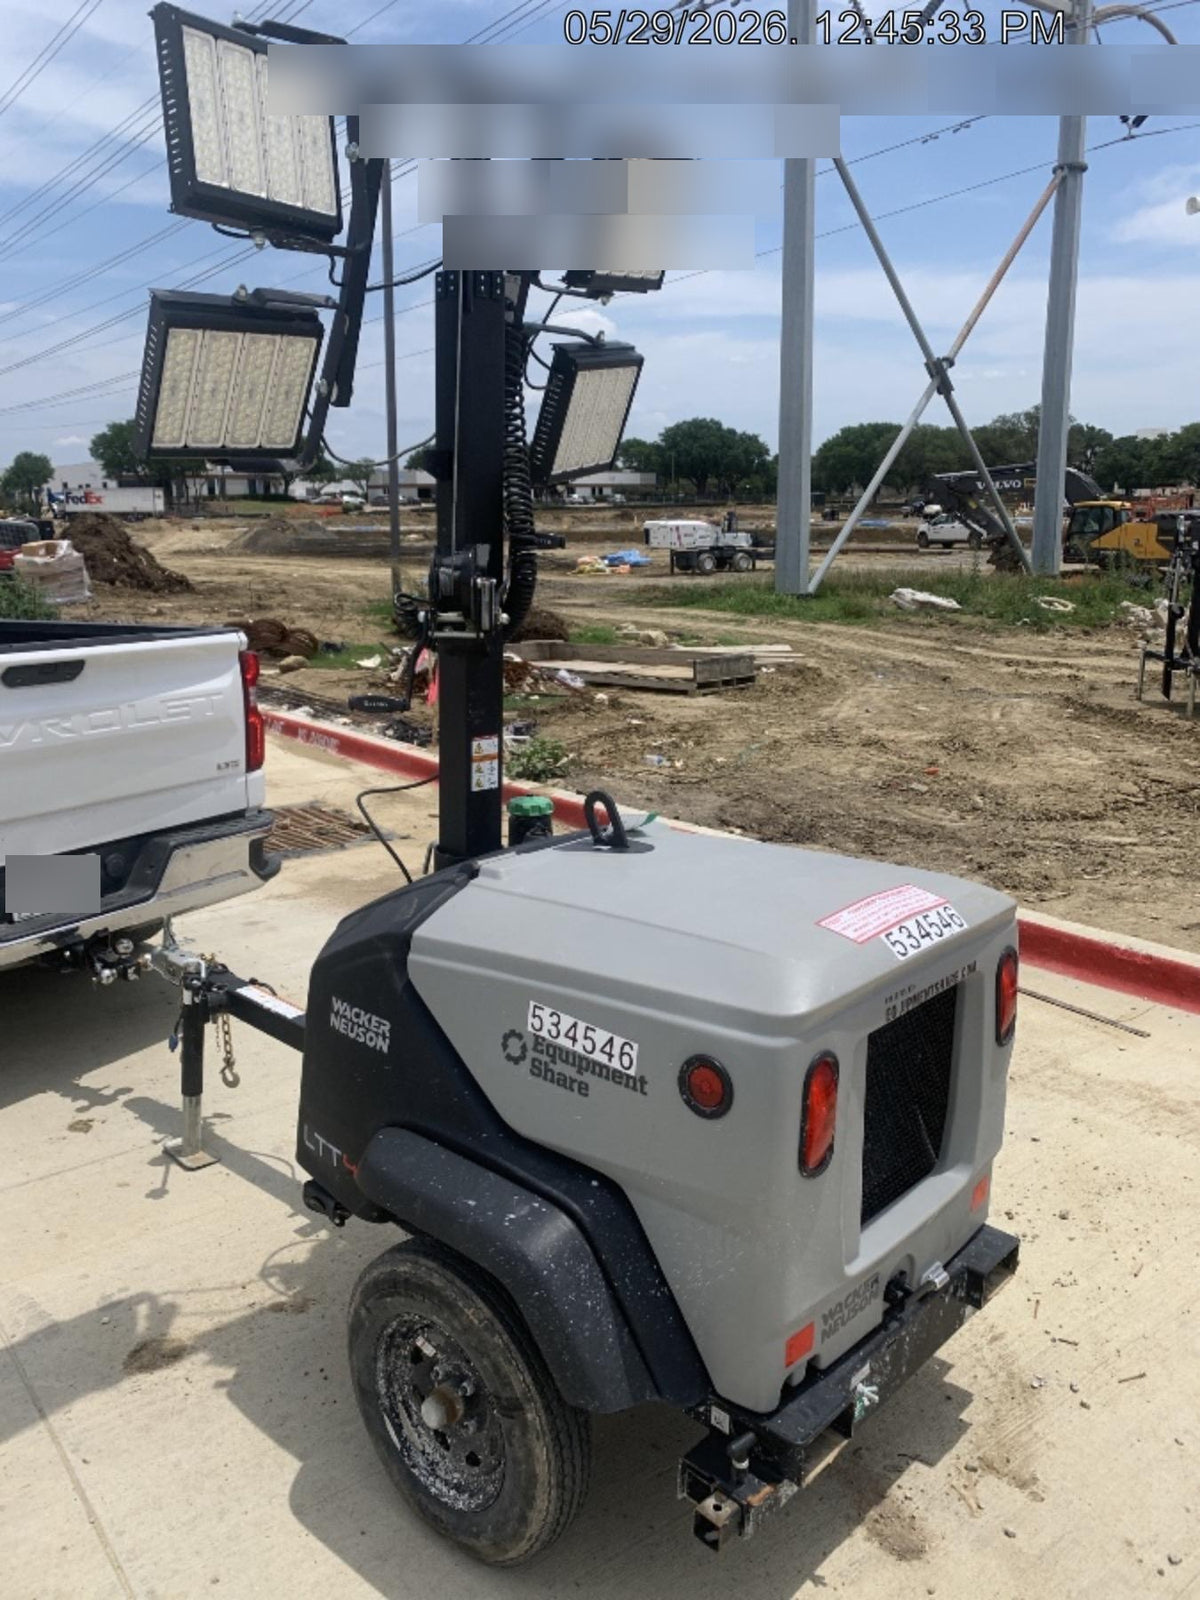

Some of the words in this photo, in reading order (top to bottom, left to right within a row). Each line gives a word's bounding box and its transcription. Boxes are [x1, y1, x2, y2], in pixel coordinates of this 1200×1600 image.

[65, 491, 104, 504] FedEx
[976, 479, 1021, 489] VLVO
[884, 906, 964, 957] 534546
[330, 1012, 390, 1054] NEUSON
[332, 995, 391, 1037] WACKER
[531, 1004, 634, 1071] 534546
[529, 1057, 590, 1098] Share
[532, 1033, 648, 1096] Equipment
